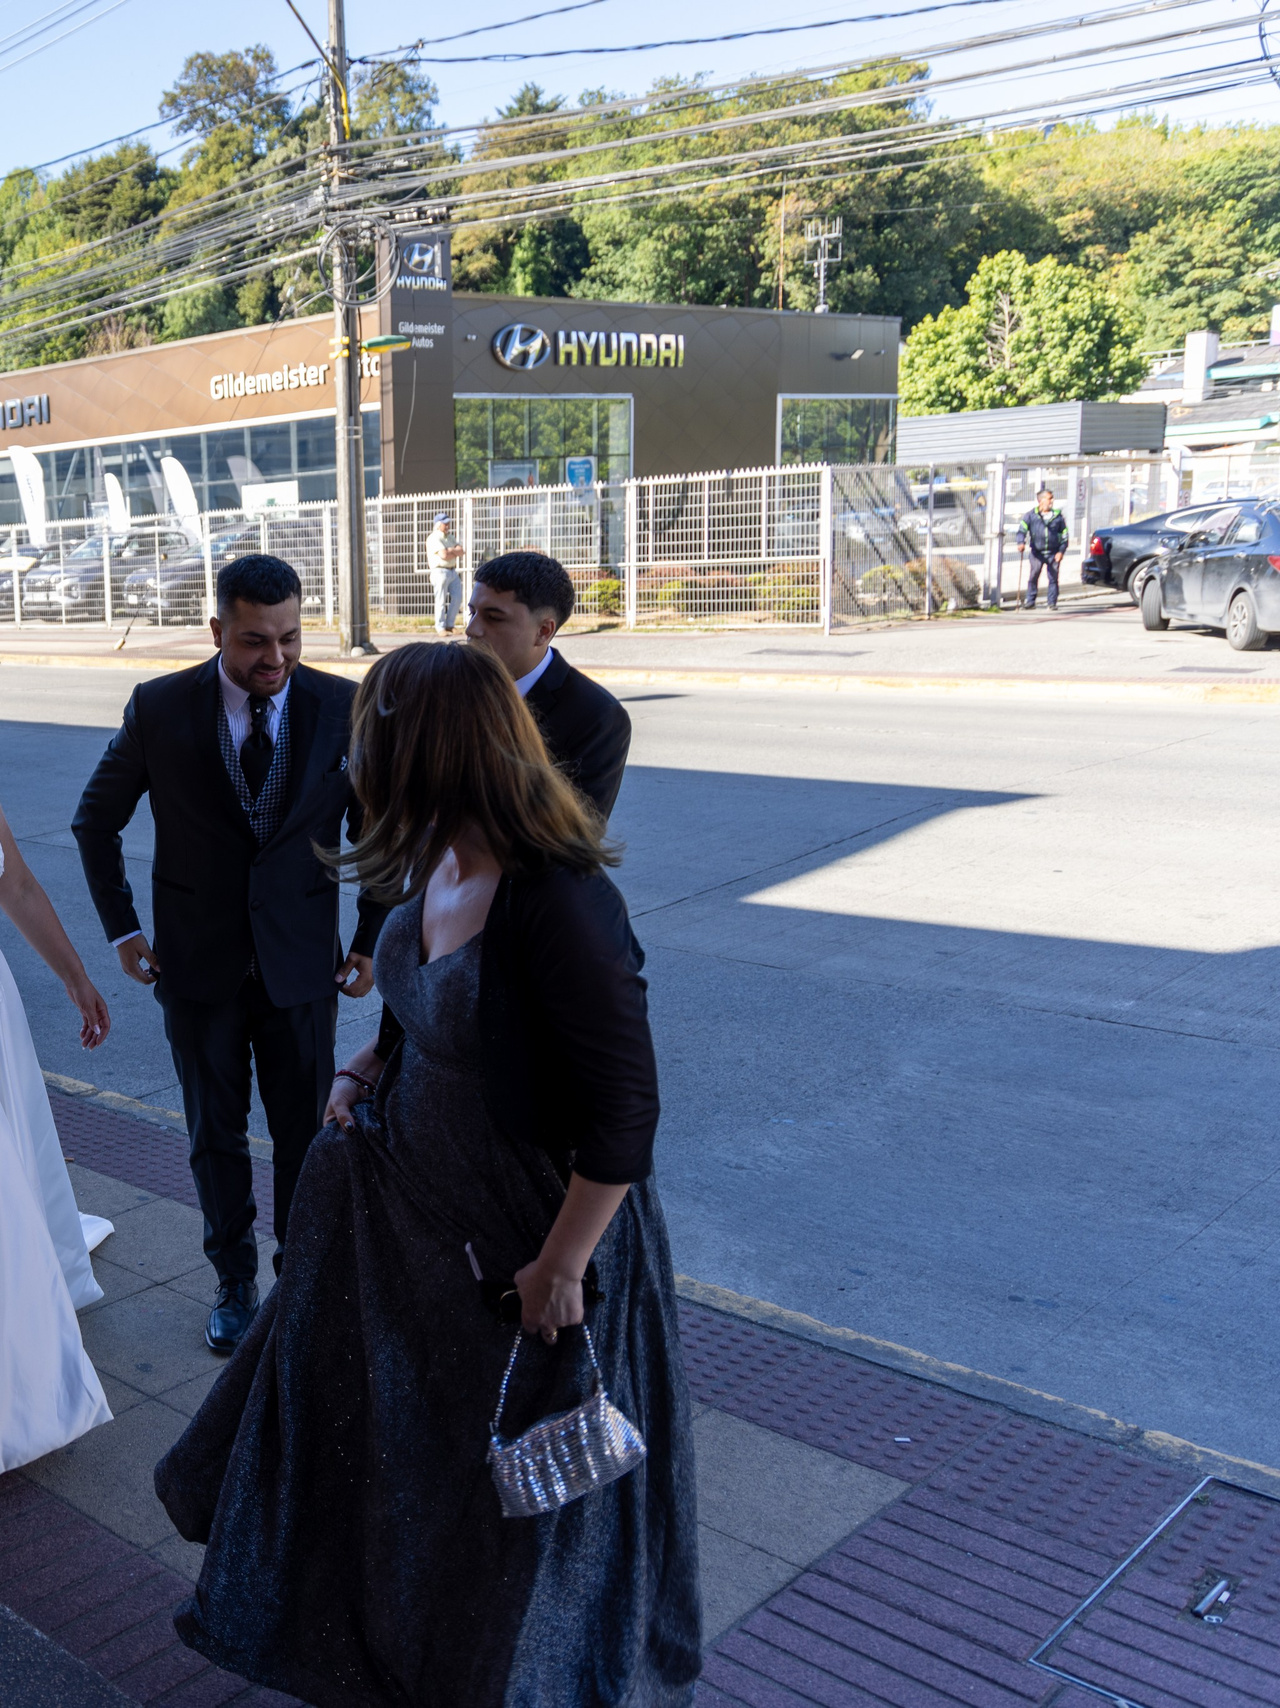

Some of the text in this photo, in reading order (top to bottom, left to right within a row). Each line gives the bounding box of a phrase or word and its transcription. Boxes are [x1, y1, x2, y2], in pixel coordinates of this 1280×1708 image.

[396, 275, 447, 291] HYUNDAI
[398, 321, 445, 335] Gildemeister
[411, 336, 434, 349] Autos
[557, 330, 685, 367] HYUNDAI
[210, 362, 329, 400] Gildemeister
